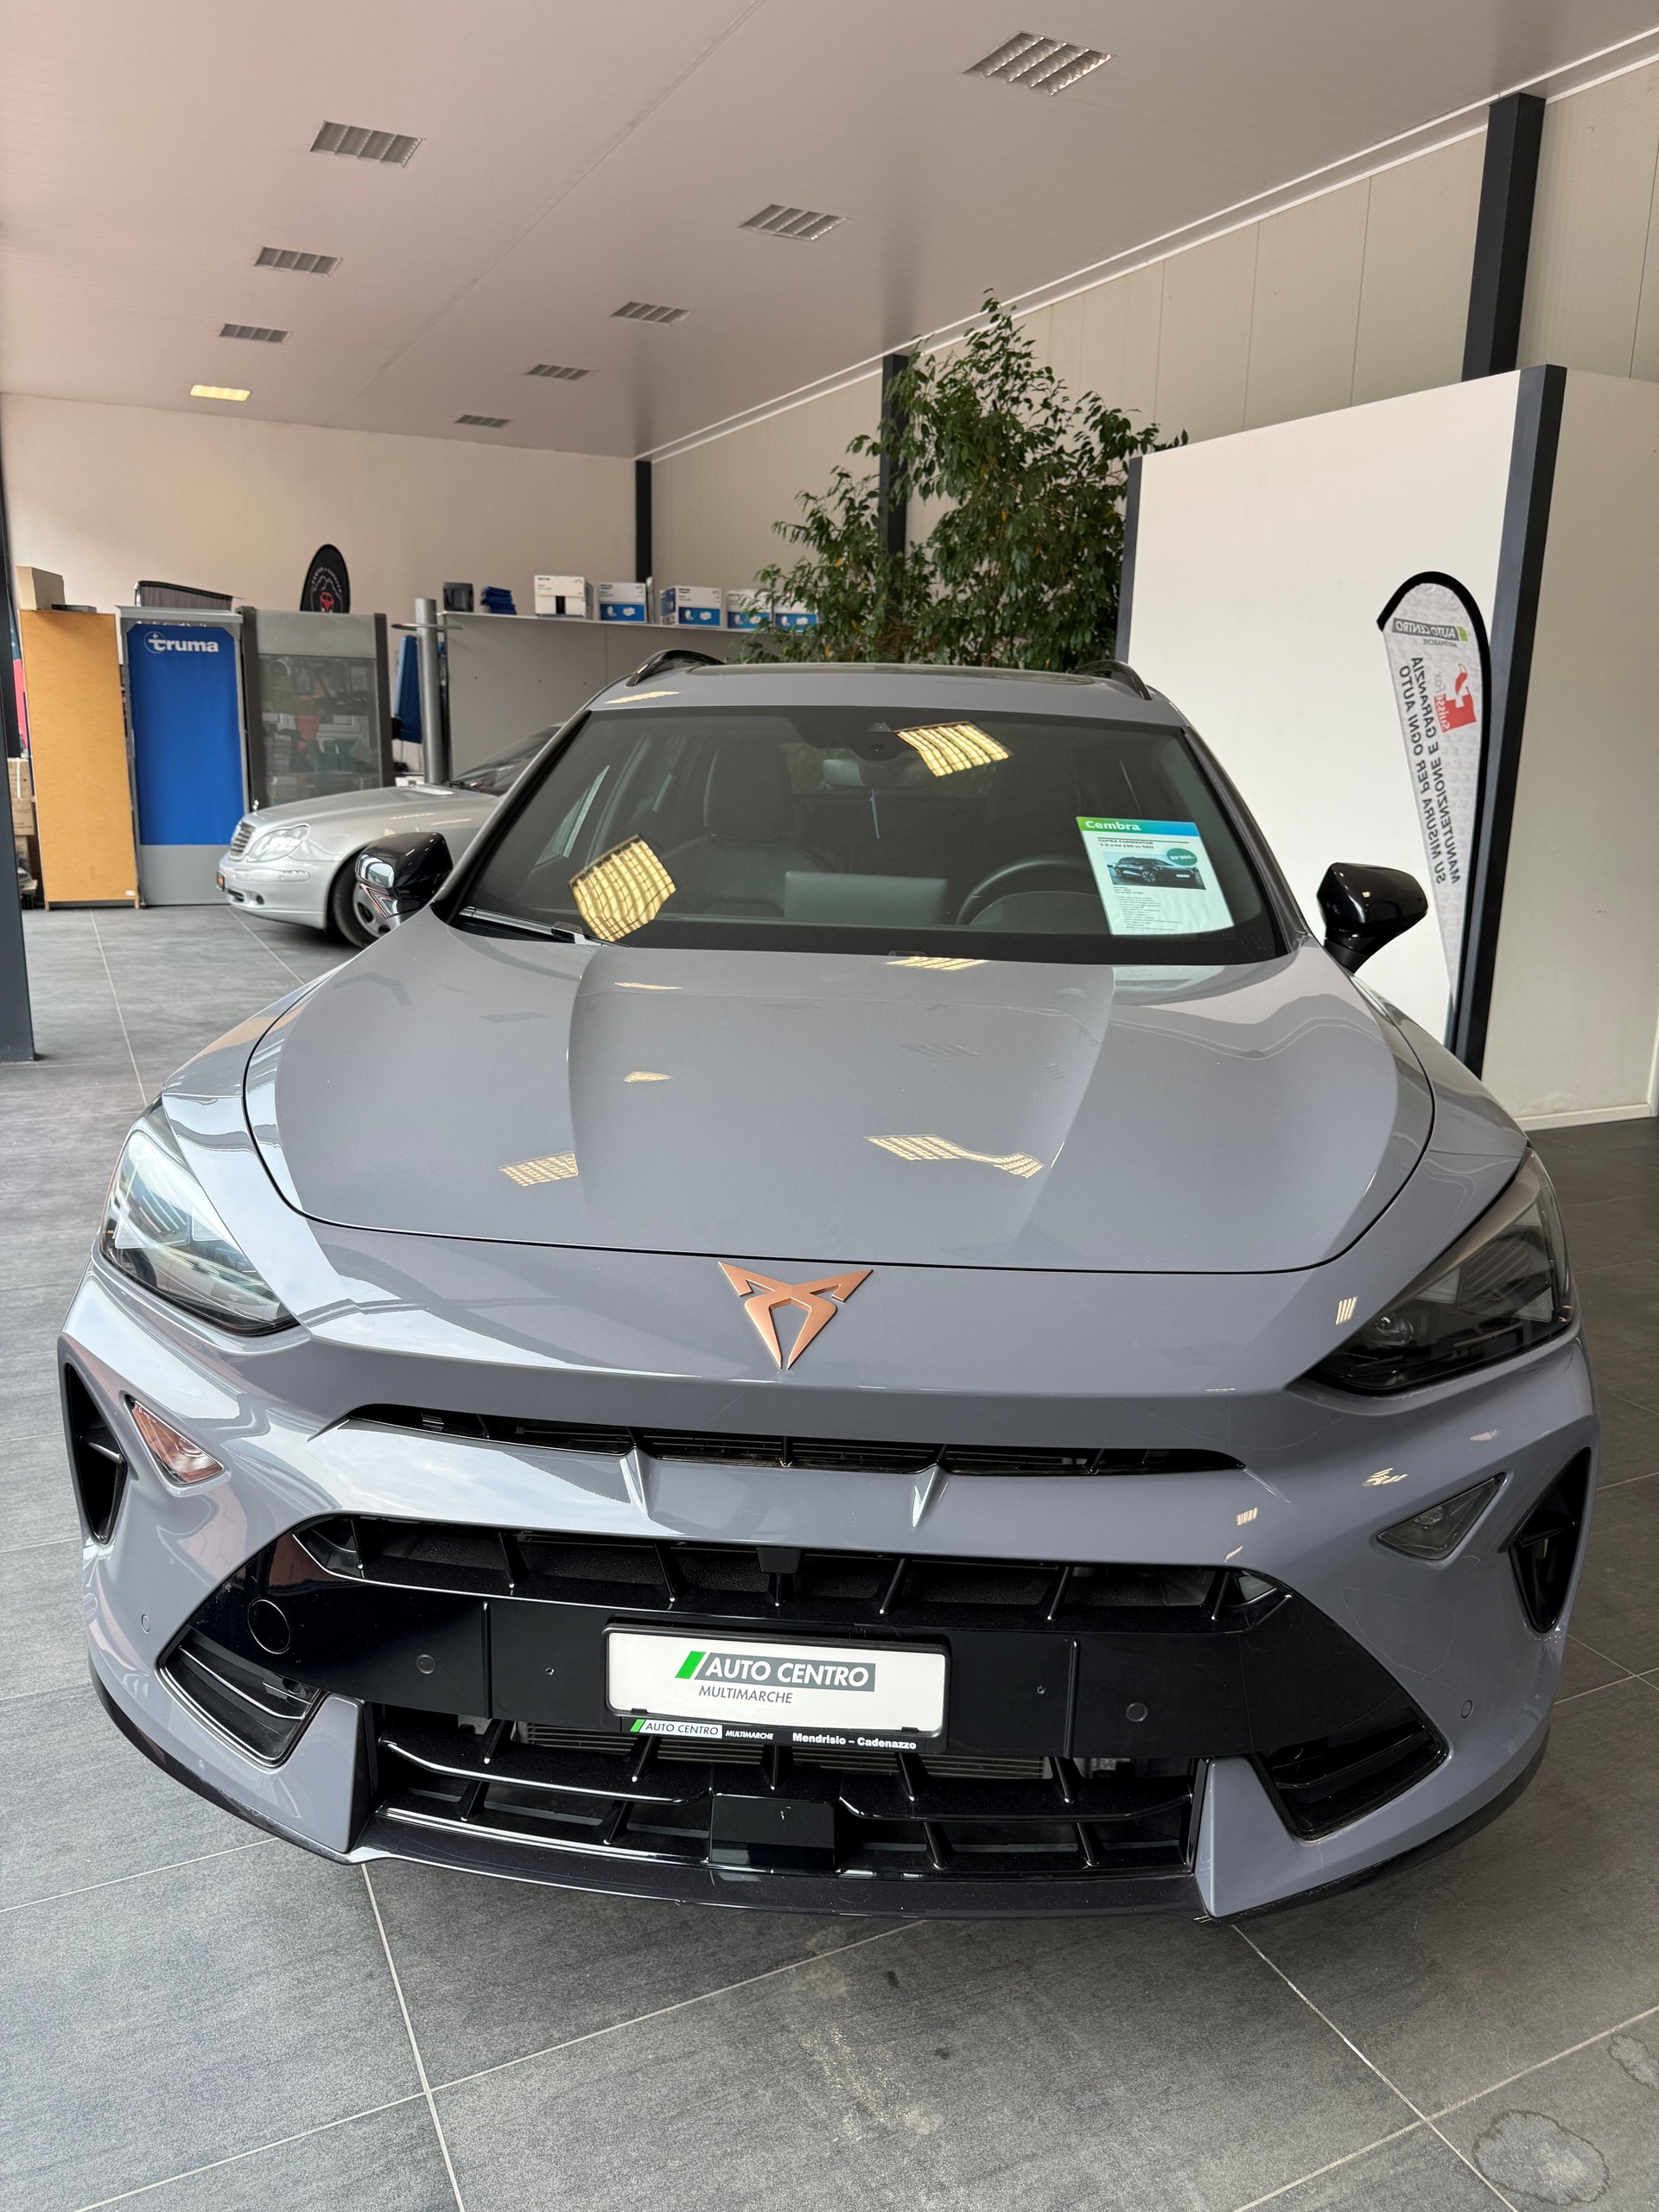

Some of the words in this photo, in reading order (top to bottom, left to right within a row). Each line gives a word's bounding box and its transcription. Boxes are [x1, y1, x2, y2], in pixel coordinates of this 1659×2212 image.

[148, 633, 219, 652] truma
[1085, 821, 1141, 830] Cembra
[705, 1657, 771, 1681] AUTO
[778, 1662, 868, 1687] CENTRO
[698, 1686, 792, 1703] MULTIMARCHE
[645, 1723, 675, 1732] AUTO
[677, 1725, 719, 1735] CENTRO
[725, 1730, 774, 1739] MULTIMARCHE
[792, 1732, 846, 1745] Mendrisio
[857, 1737, 917, 1750] Cadenazzo
